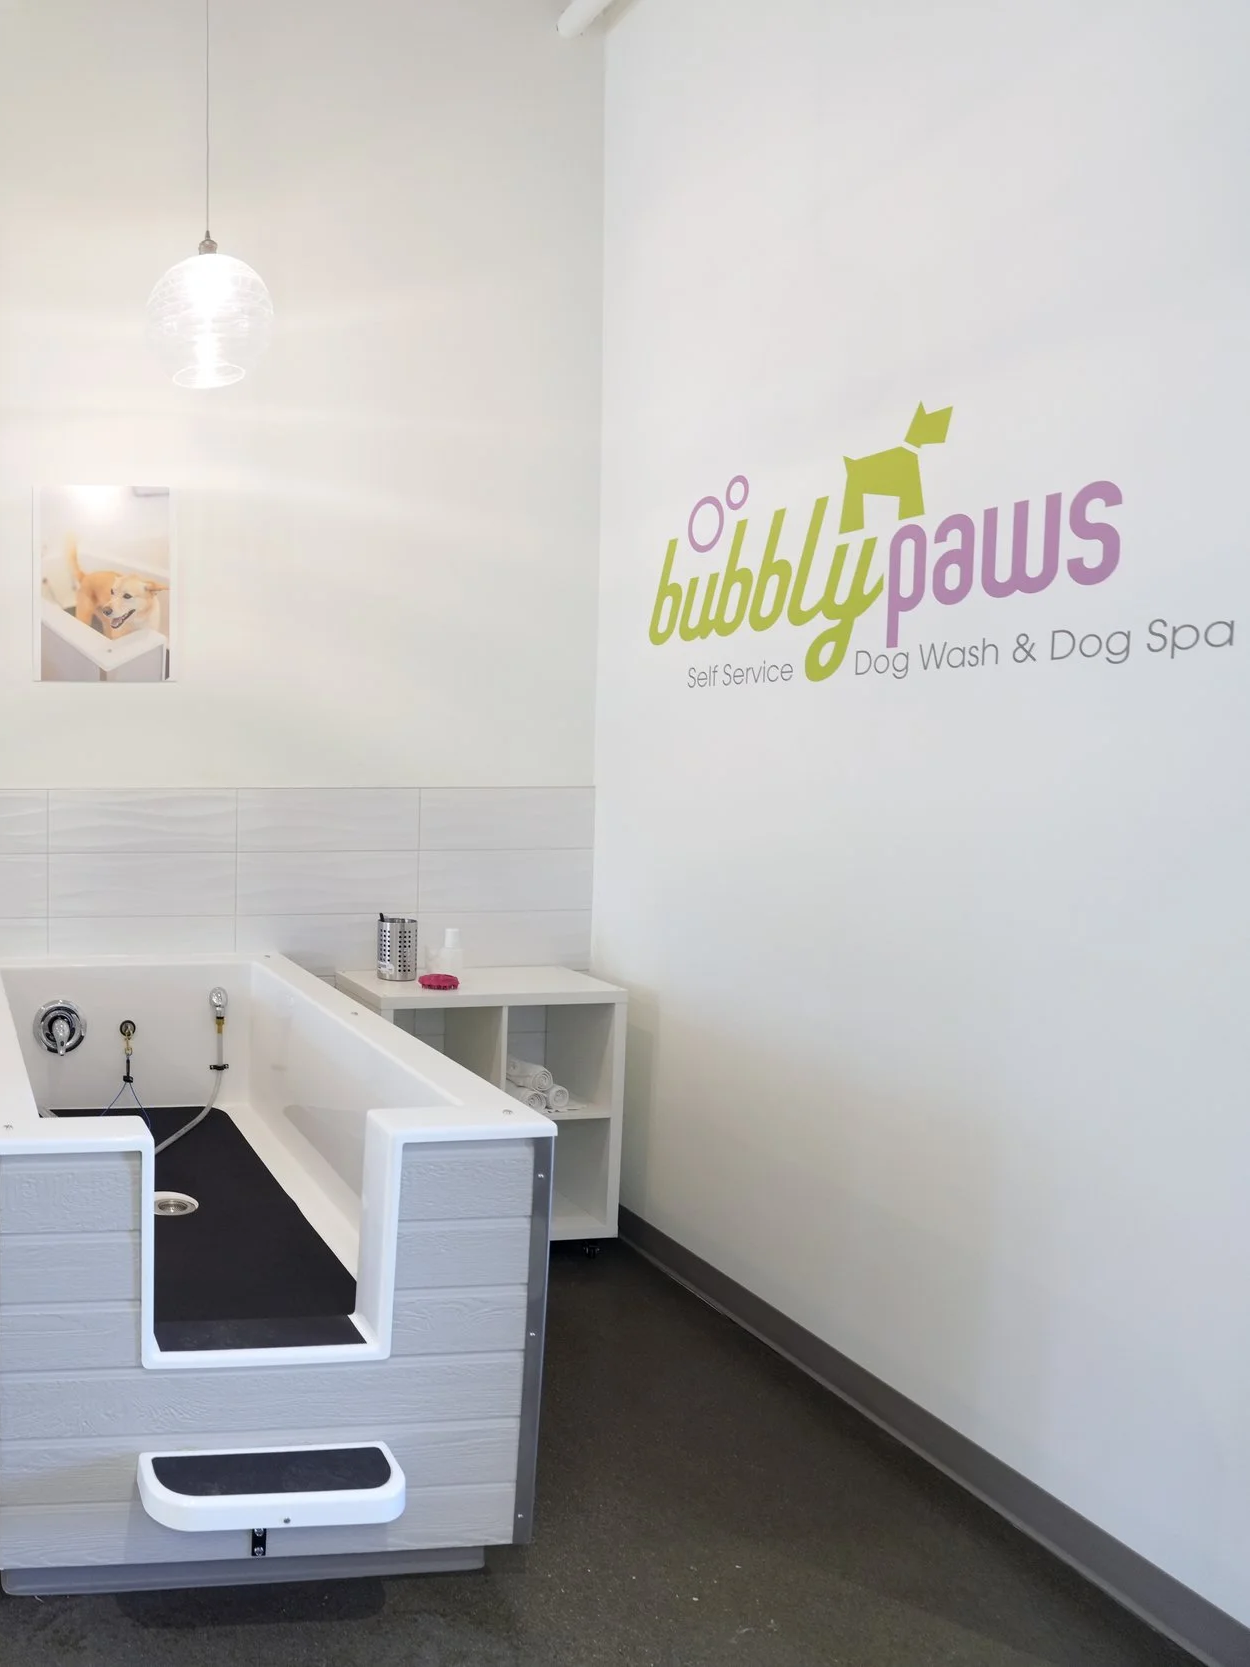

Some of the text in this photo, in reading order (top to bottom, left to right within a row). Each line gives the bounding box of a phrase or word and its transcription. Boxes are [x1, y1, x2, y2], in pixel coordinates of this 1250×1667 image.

[687, 618, 1236, 689] Self Service Dog Wash & Dog Spa
